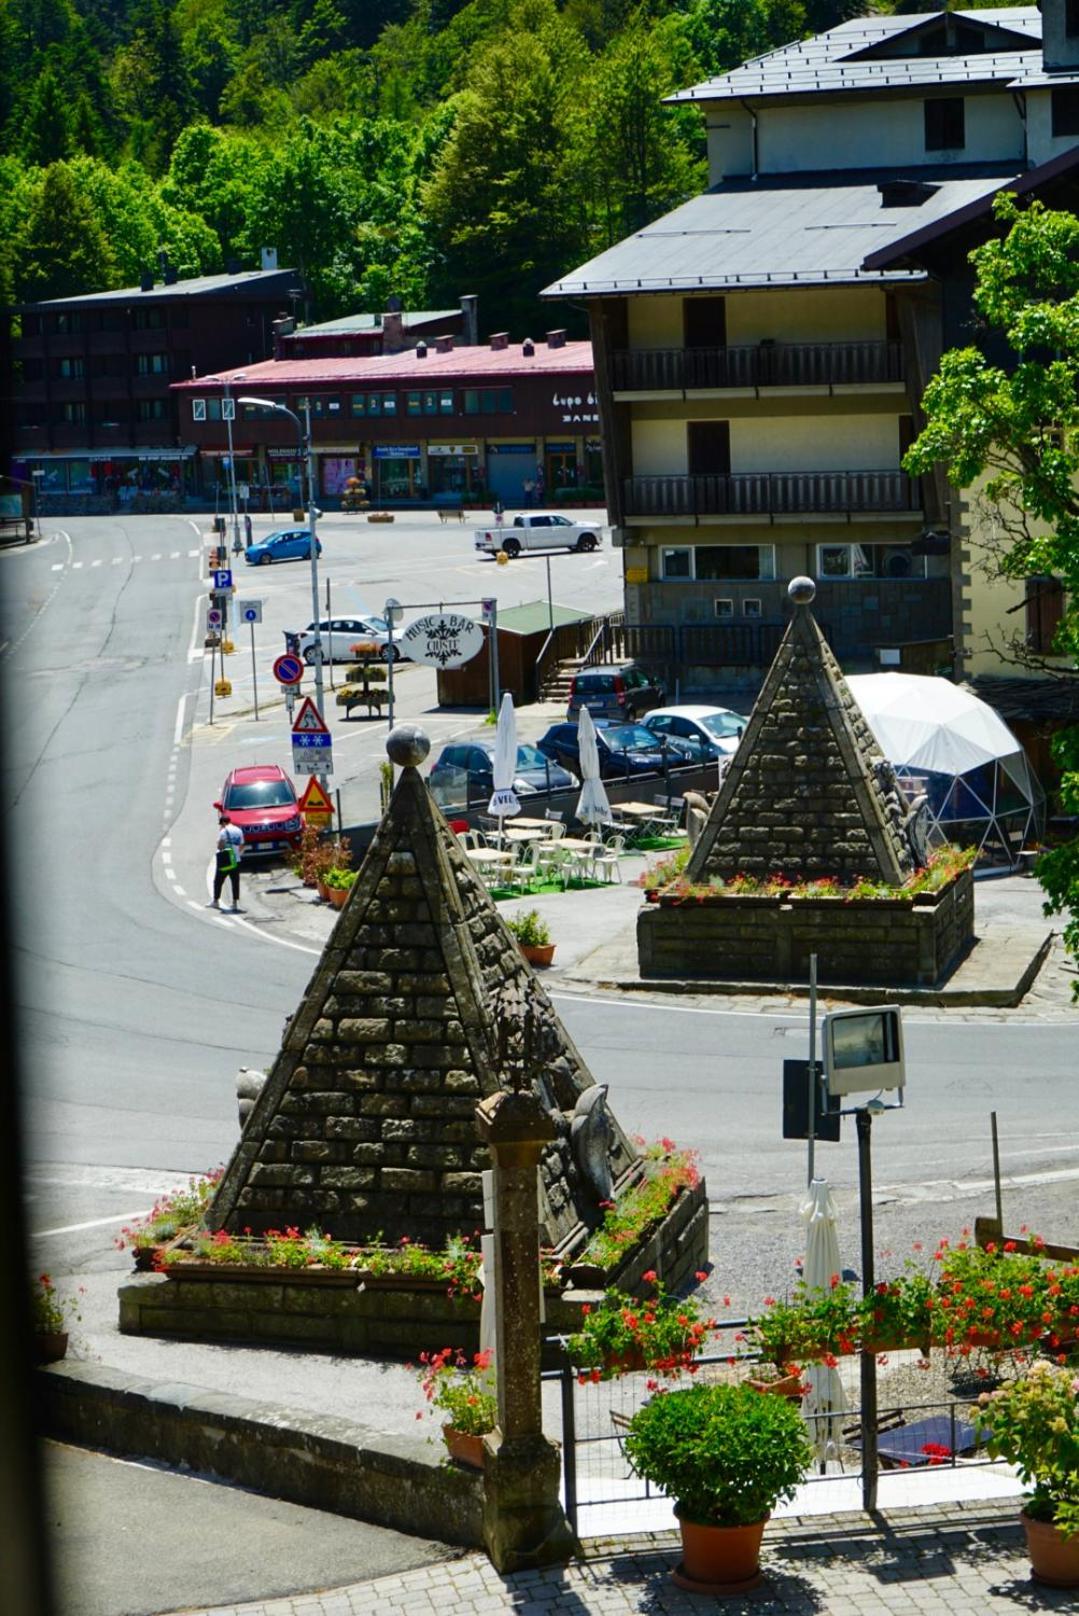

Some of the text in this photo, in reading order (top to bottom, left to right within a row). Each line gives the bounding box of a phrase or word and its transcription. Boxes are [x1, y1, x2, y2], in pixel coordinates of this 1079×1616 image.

[217, 572, 229, 587] P
[405, 615, 474, 641] MUSIC BAR
